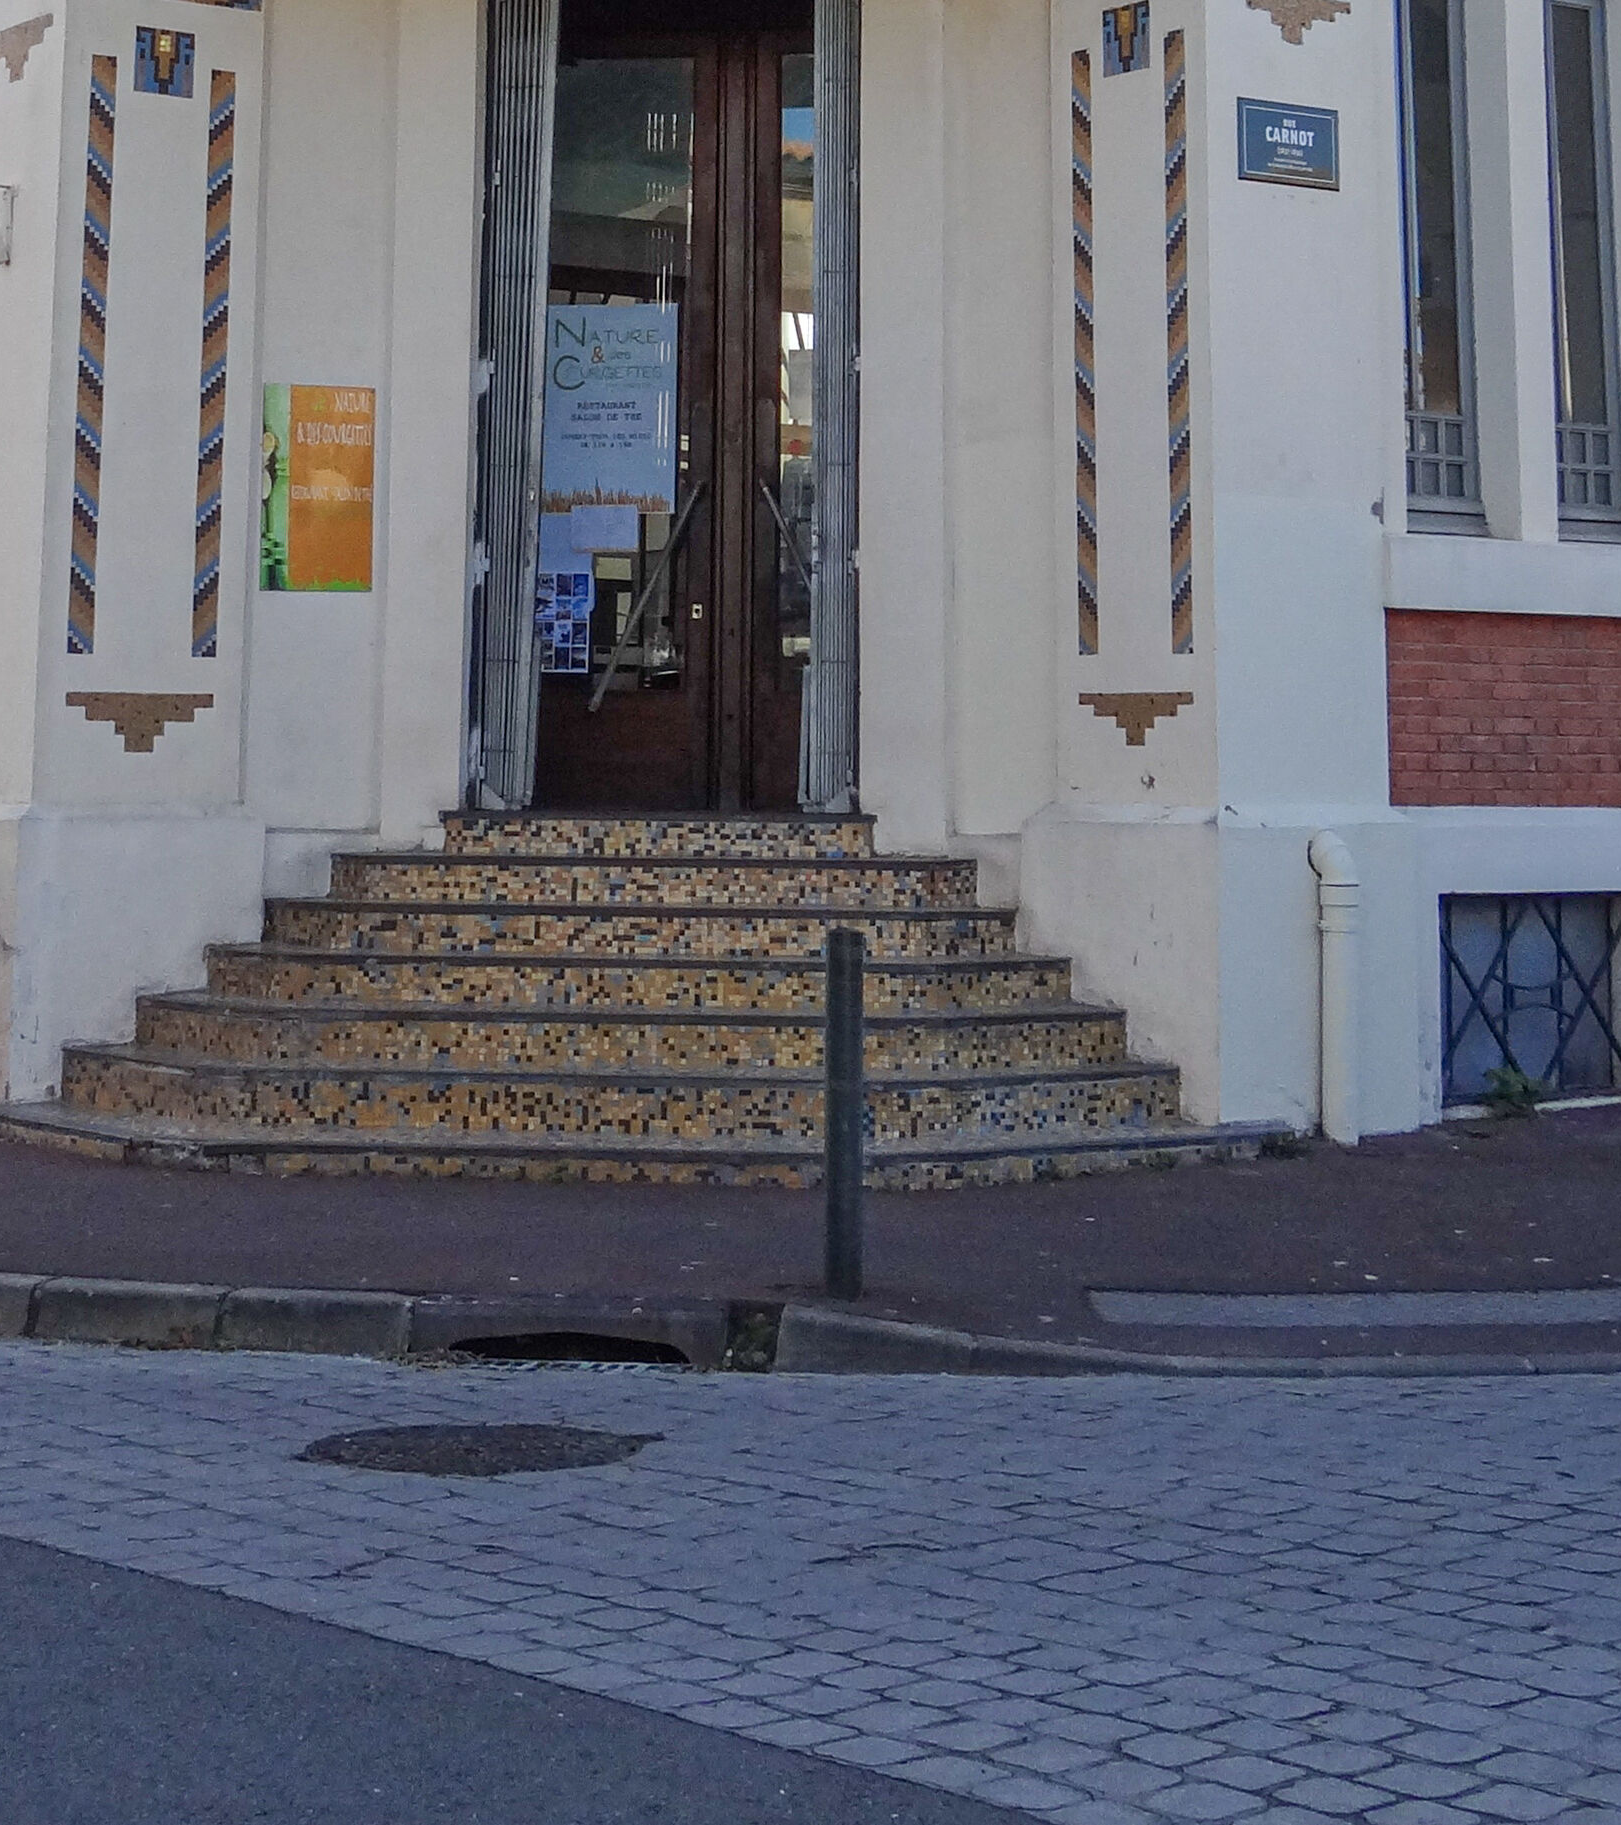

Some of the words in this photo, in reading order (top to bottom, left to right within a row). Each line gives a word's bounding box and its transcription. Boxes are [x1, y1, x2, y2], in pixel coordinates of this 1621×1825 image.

[1283, 118, 1296, 128] RUE
[1265, 126, 1315, 147] CARNOT
[555, 316, 659, 347] NATURE
[591, 345, 605, 363] &
